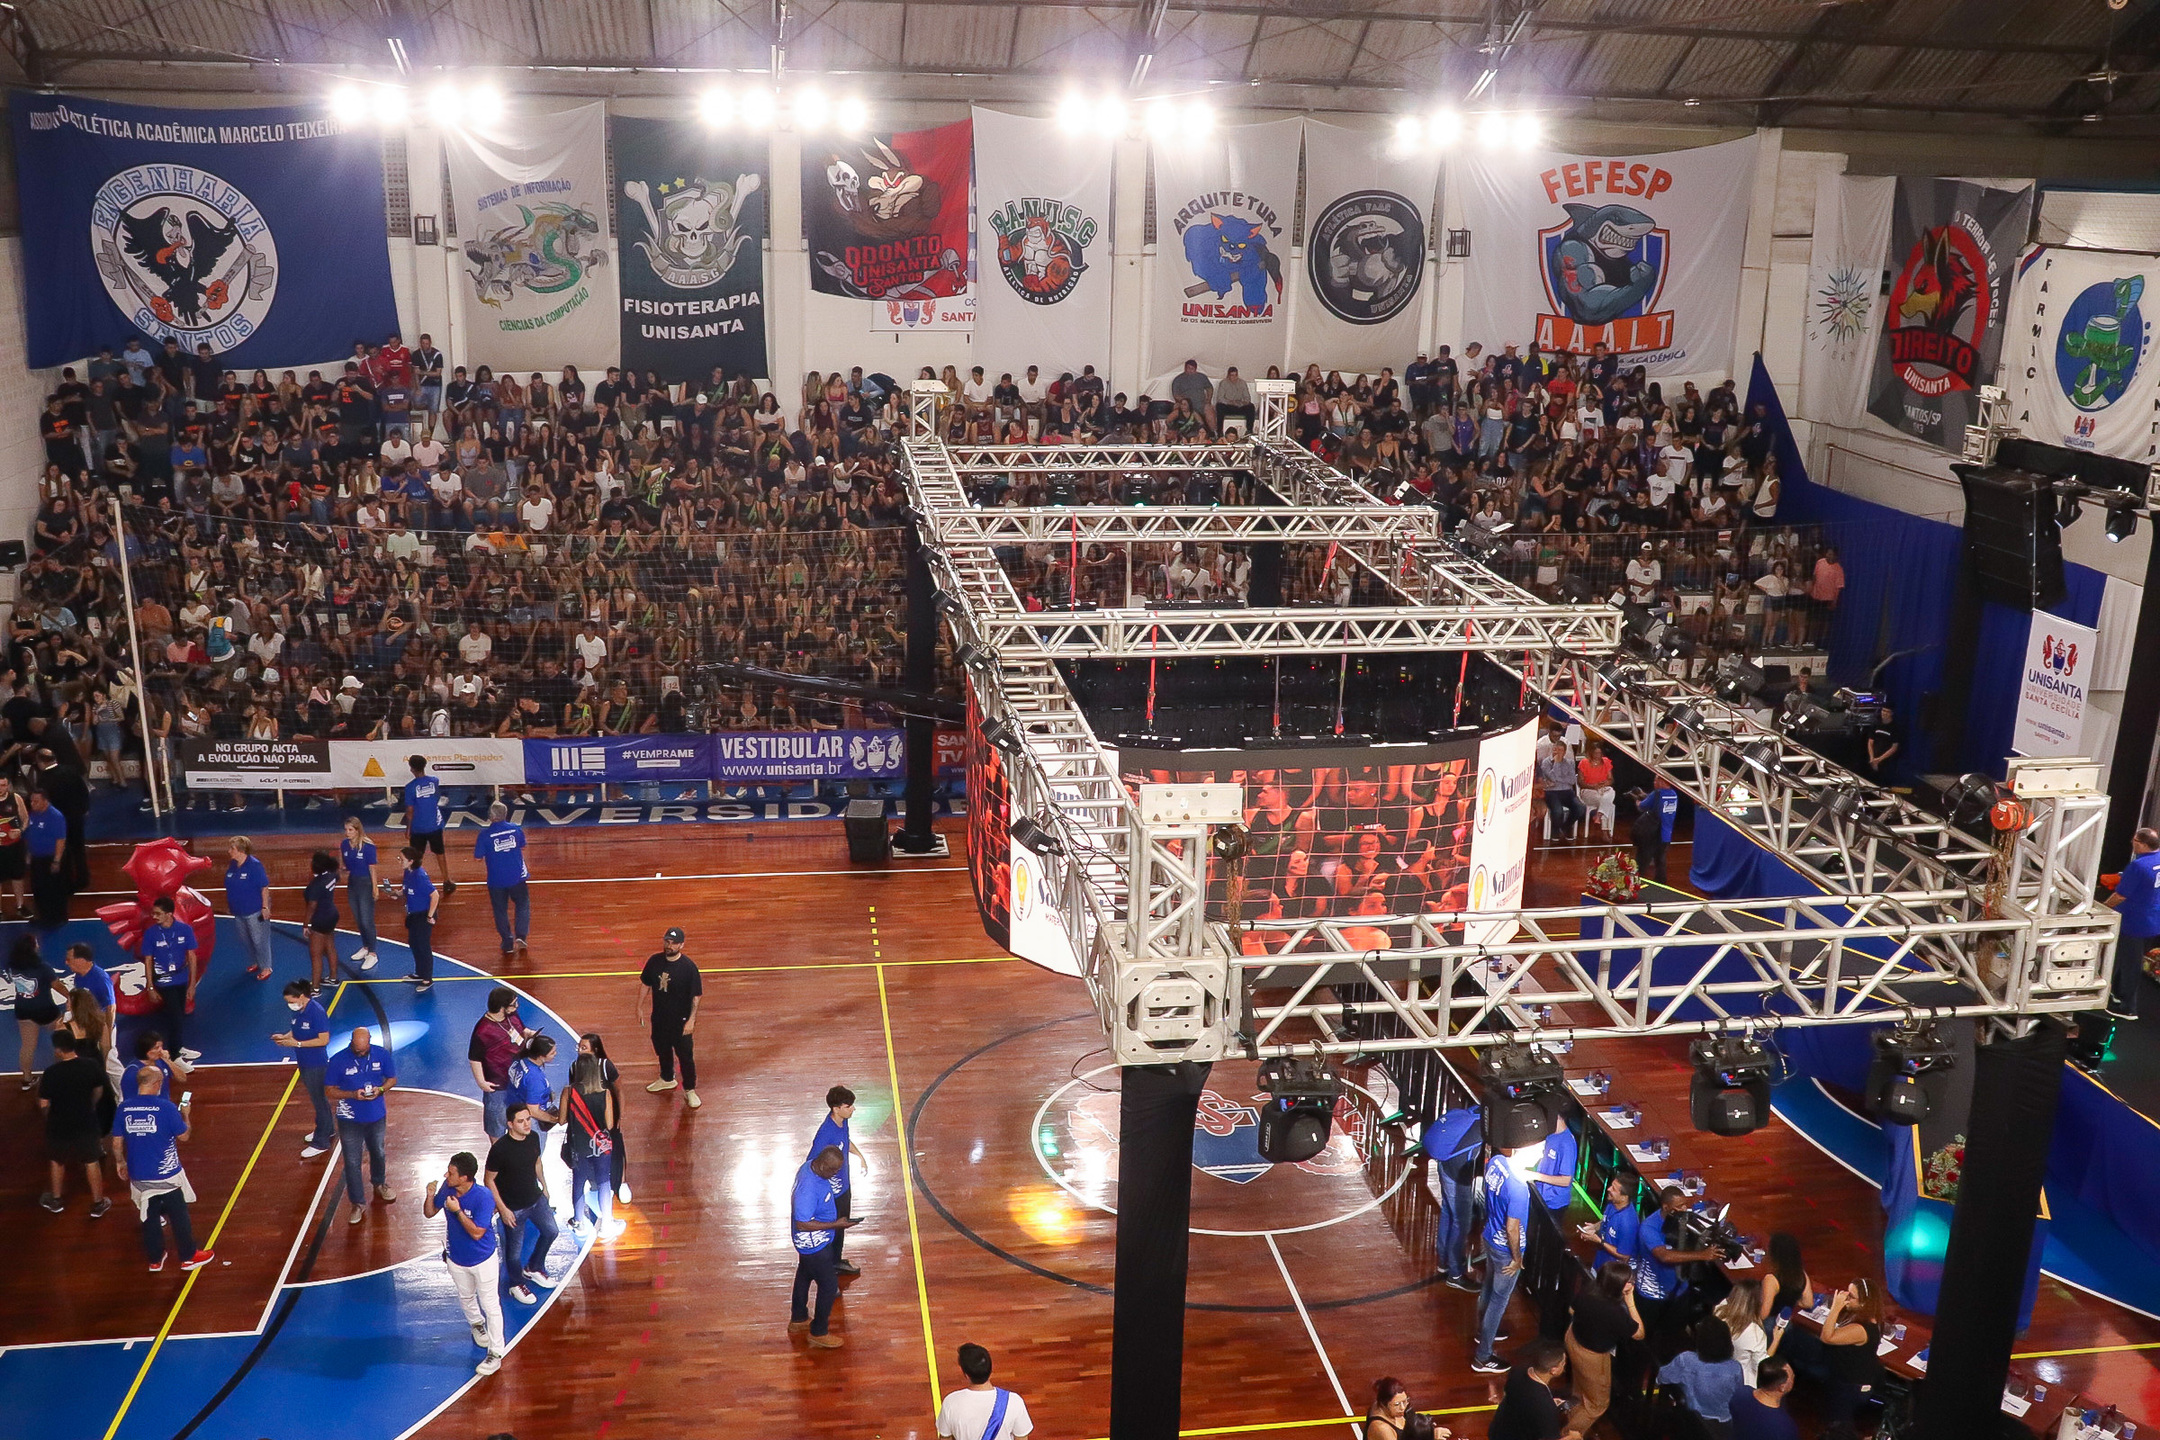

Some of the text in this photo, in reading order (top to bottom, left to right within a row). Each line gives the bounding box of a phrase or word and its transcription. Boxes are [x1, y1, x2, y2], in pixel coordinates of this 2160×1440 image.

[69, 111, 133, 139] ATLÉTICA
[136, 122, 217, 144] ACADÊMICA
[219, 124, 284, 144] MARCELO
[477, 178, 571, 211] SISTEMAS DE INFORMAÇÃO
[1540, 160, 1673, 204] FEFESP
[93, 166, 268, 242] ENGENHARIA
[1172, 191, 1283, 238] ARQUITETURA
[1962, 213, 1992, 255] TERROR
[844, 235, 942, 269] ODONTO
[853, 255, 941, 287] UNISANTA
[867, 271, 923, 298] SANTOS
[534, 316, 546, 328] DA
[546, 287, 589, 324] COMPUTAÇÃO
[624, 291, 761, 317] FISIOTERAPIA
[1034, 296, 1044, 304] DE
[1182, 303, 1273, 318] UNISANTA
[133, 306, 254, 354] SANTOS
[641, 318, 745, 340] UNISANTA
[1903, 366, 1951, 395] UNISANTA
[2063, 433, 2096, 449] UNISANTA
[2024, 691, 2048, 707] SANTA
[2026, 683, 2082, 712] UNIVERSIDADE
[2028, 669, 2083, 702] UNISANTA
[198, 753, 318, 764] A EVOLUÇÃO NÃO PARA.
[215, 743, 299, 753] NO GRUPO AKTA
[402, 753, 504, 764] Aientes Planejados
[622, 749, 695, 759] #VEMPRAME
[720, 735, 844, 759] VESTIBULAR
[938, 751, 963, 763] TV
[722, 761, 843, 776] www.unisanta.br
